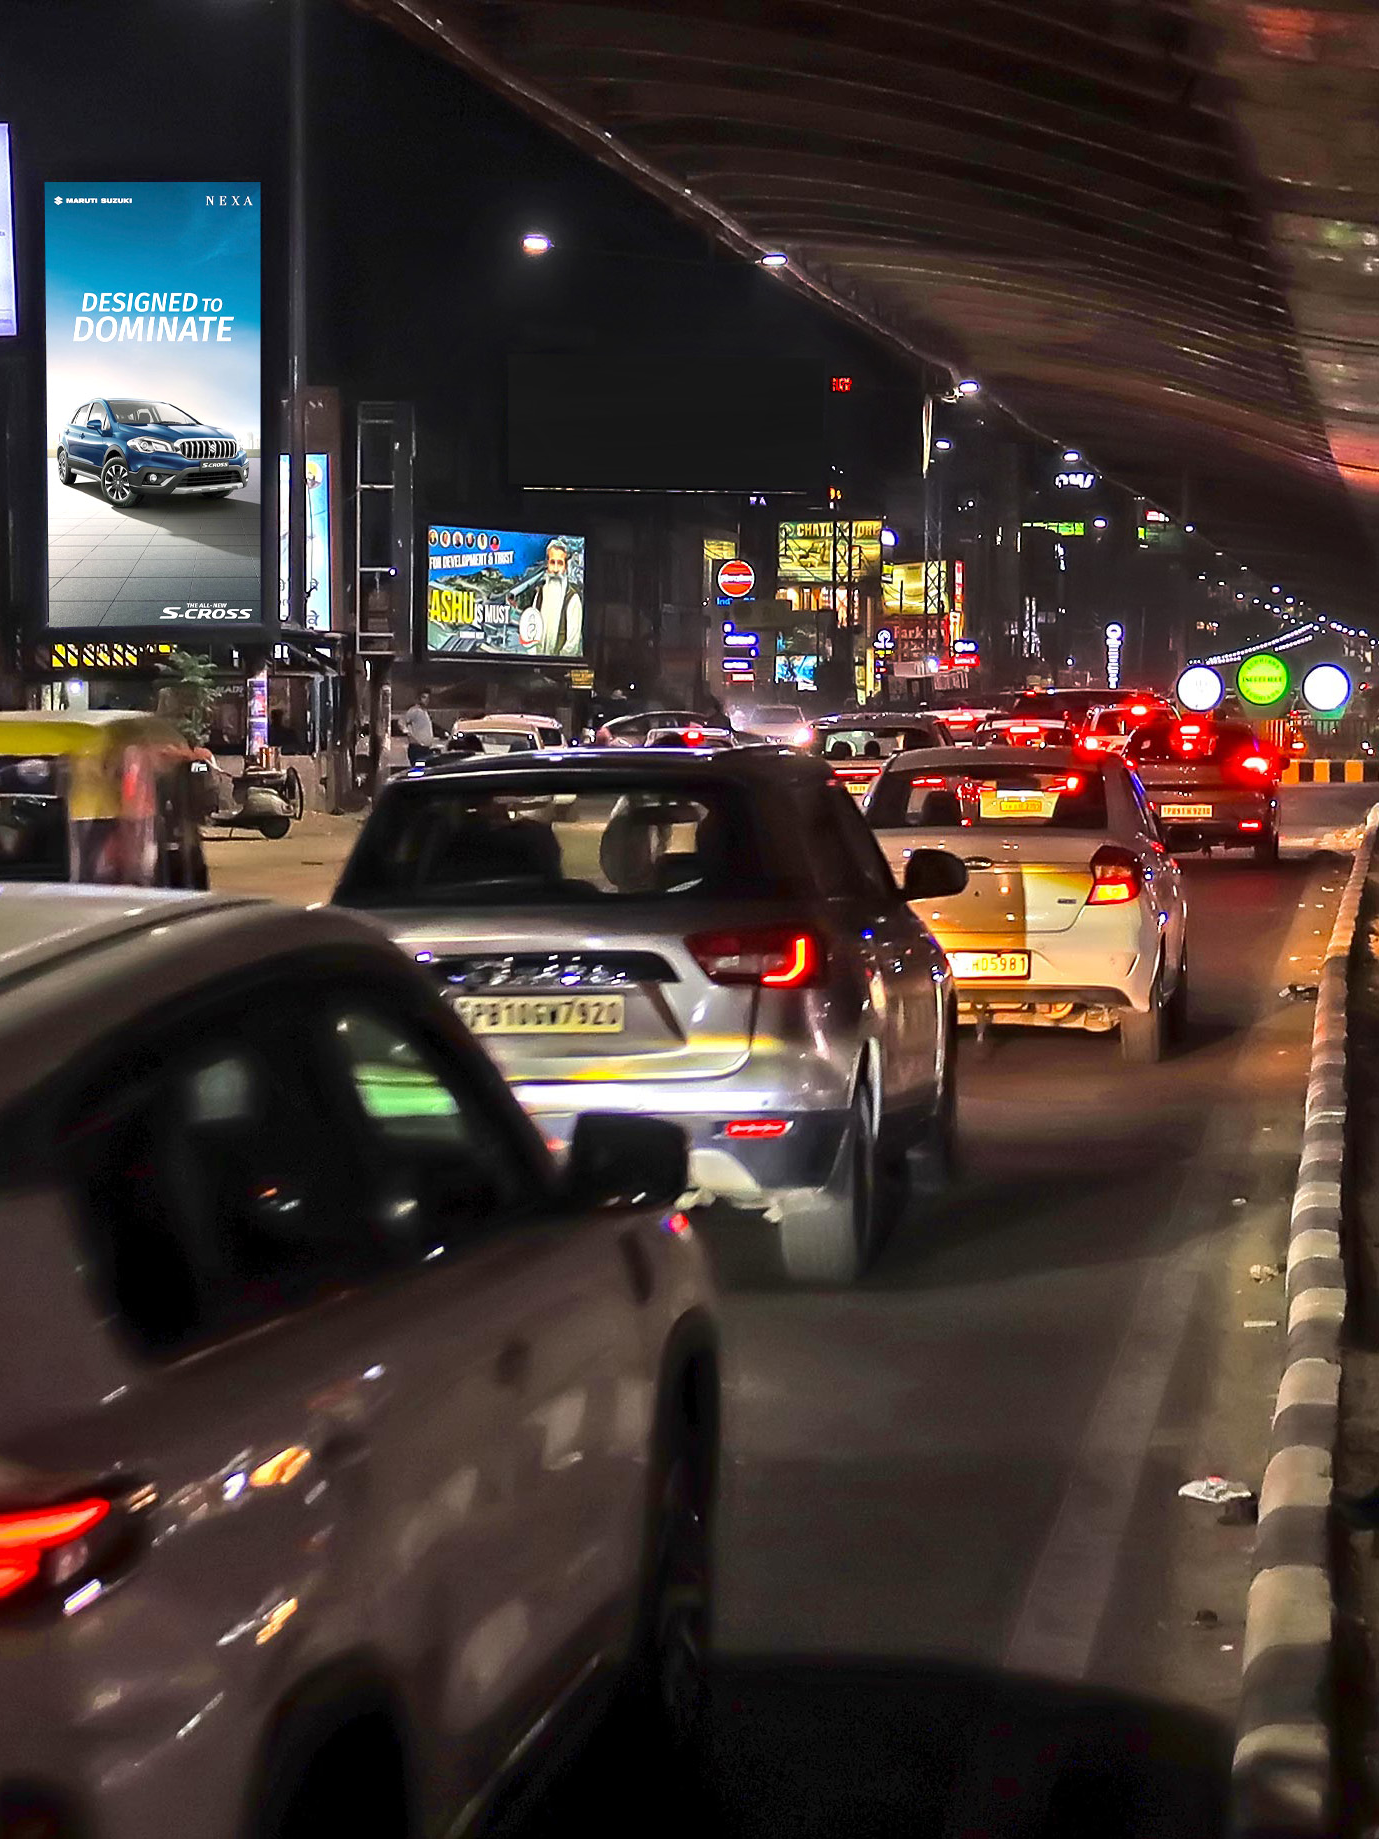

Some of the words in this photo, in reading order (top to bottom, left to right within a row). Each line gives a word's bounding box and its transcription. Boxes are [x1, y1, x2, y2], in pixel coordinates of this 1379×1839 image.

[205, 195, 253, 206] NEXA
[82, 292, 198, 313] DESIGNED
[201, 298, 223, 312] TO
[73, 316, 235, 342] DOMINATE
[442, 552, 488, 569] DEVELOPMENT
[159, 607, 253, 620] S-CROSS
[429, 590, 474, 624] ASHU
[484, 605, 511, 624] MUST
